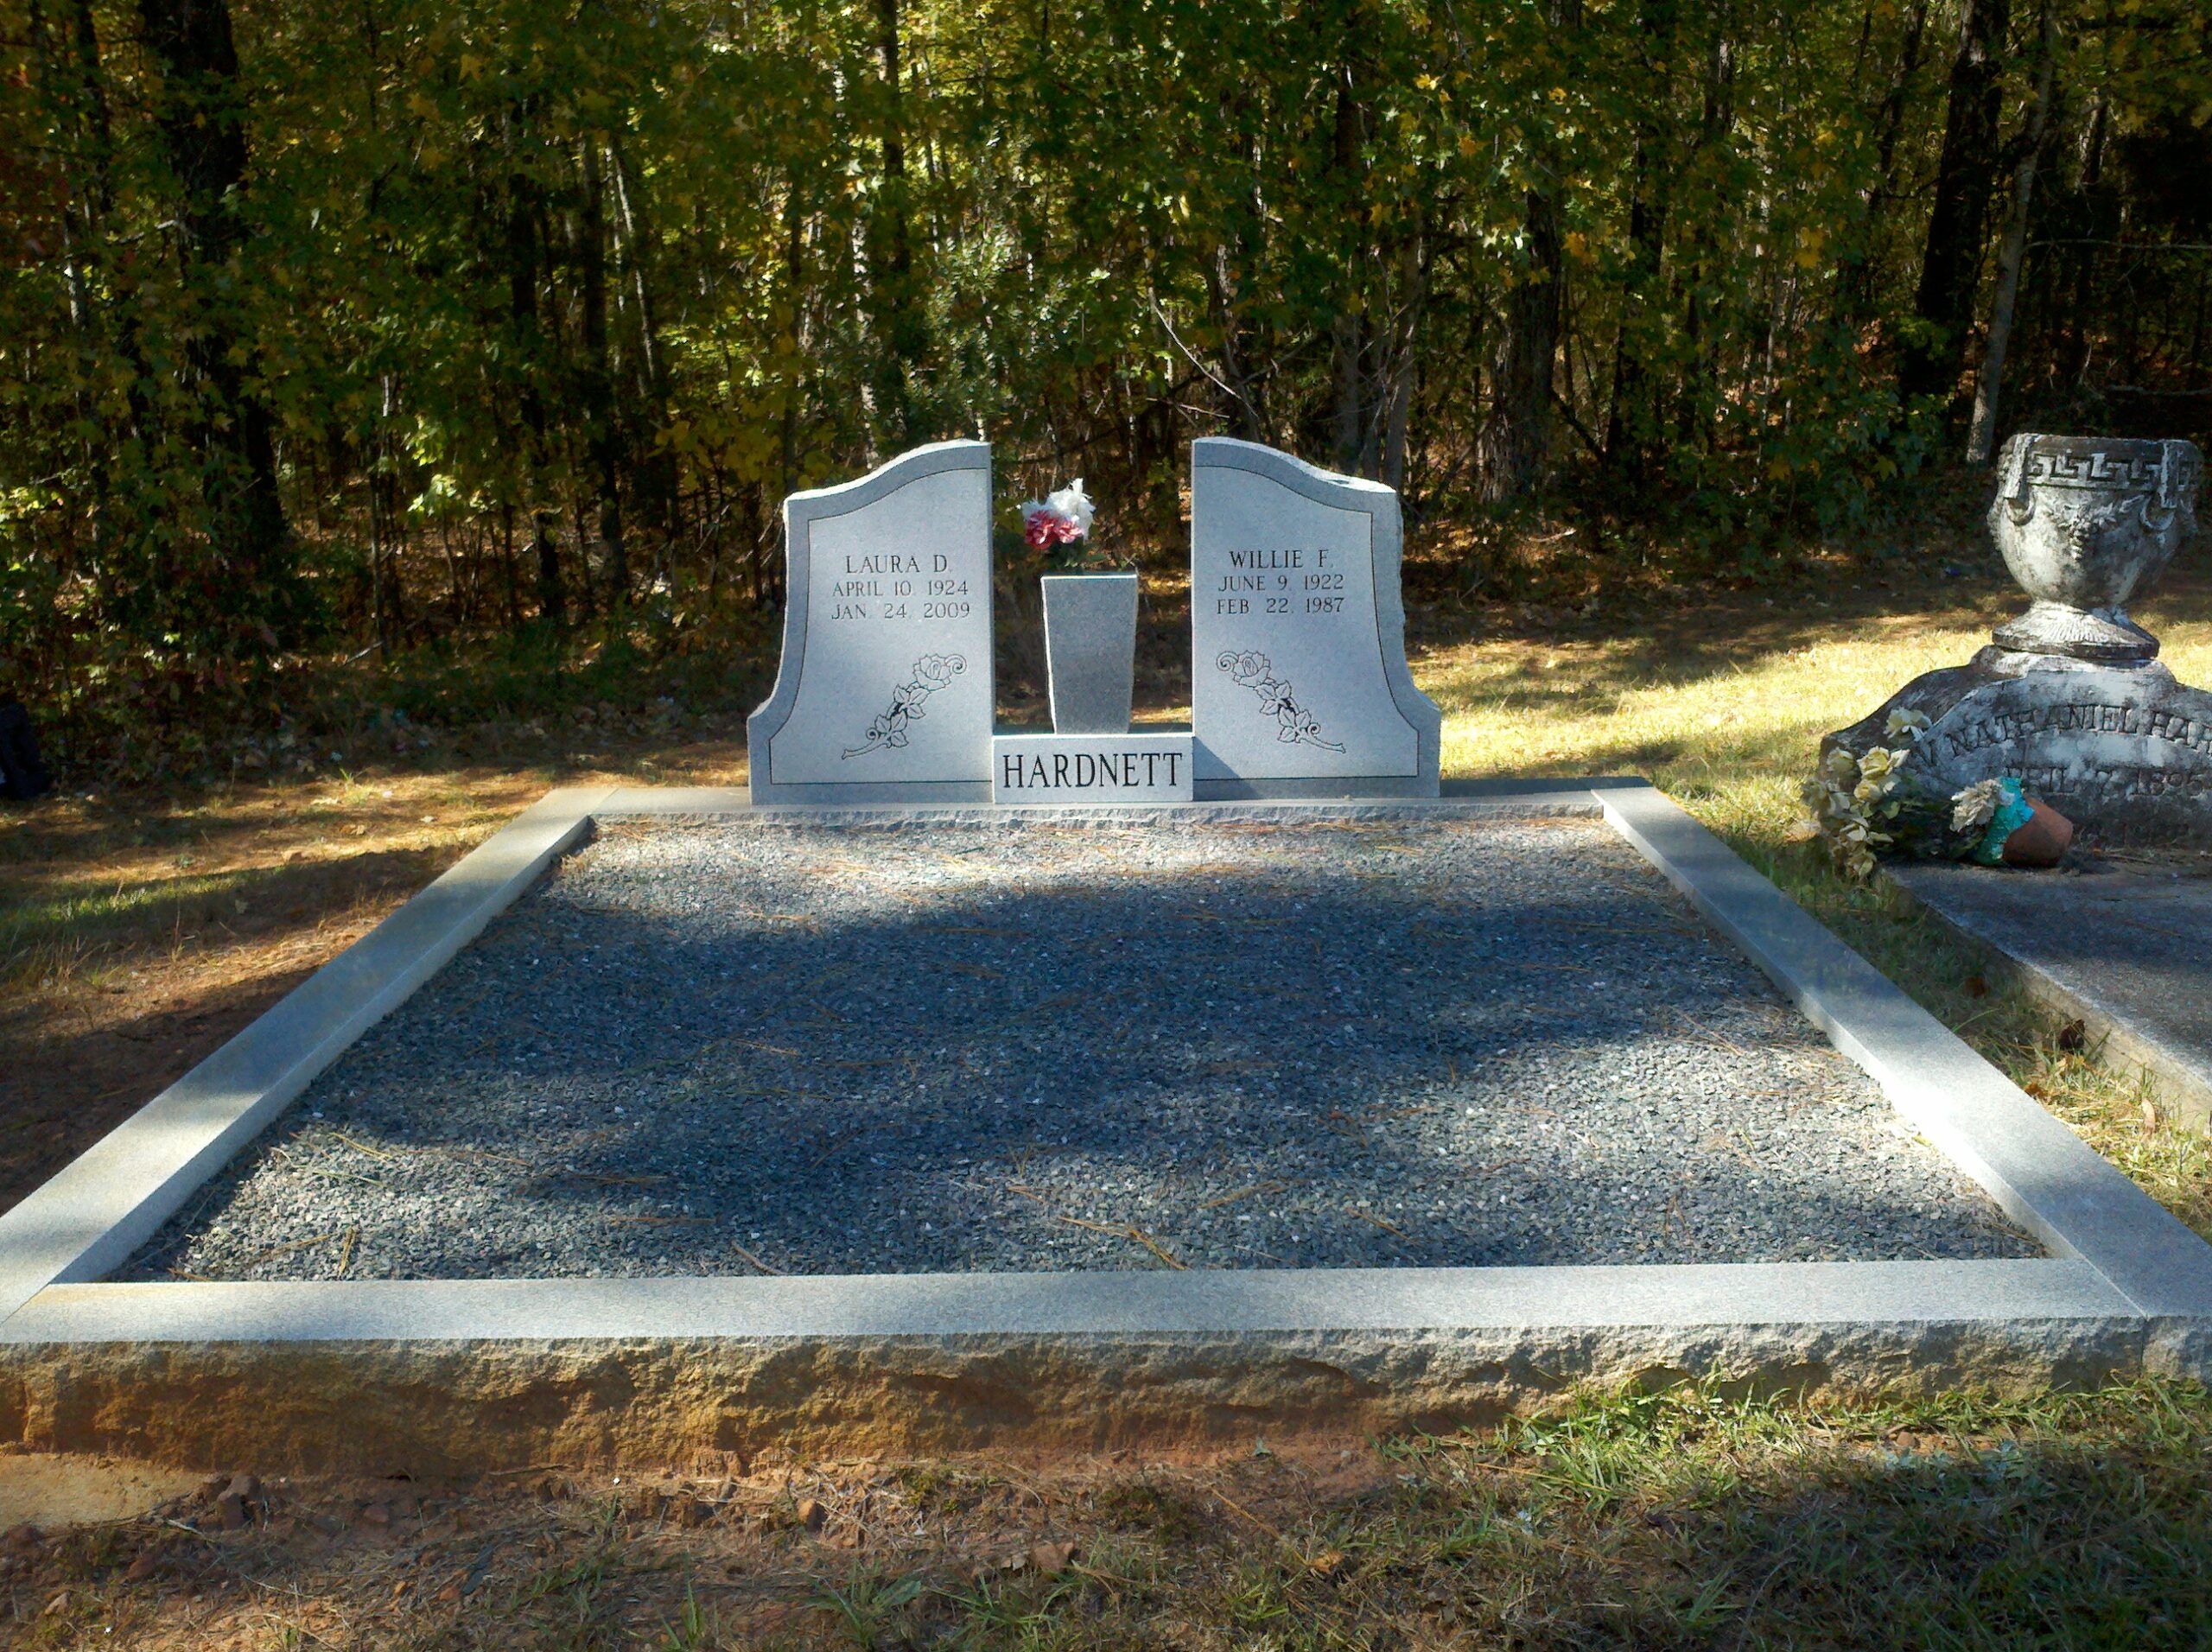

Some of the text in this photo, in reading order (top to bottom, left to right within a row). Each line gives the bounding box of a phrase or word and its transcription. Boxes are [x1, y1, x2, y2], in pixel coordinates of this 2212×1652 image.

[846, 555, 920, 574] LAURA
[1229, 549, 1304, 569] WILLIE
[832, 581, 884, 597] APRIL
[928, 579, 969, 596] 1924
[1217, 575, 1266, 592] JUNE
[1305, 574, 1344, 590] 1922
[923, 601, 969, 619] 2009
[1306, 596, 1344, 613] 1987
[1002, 753, 1183, 788] HARDNETT
